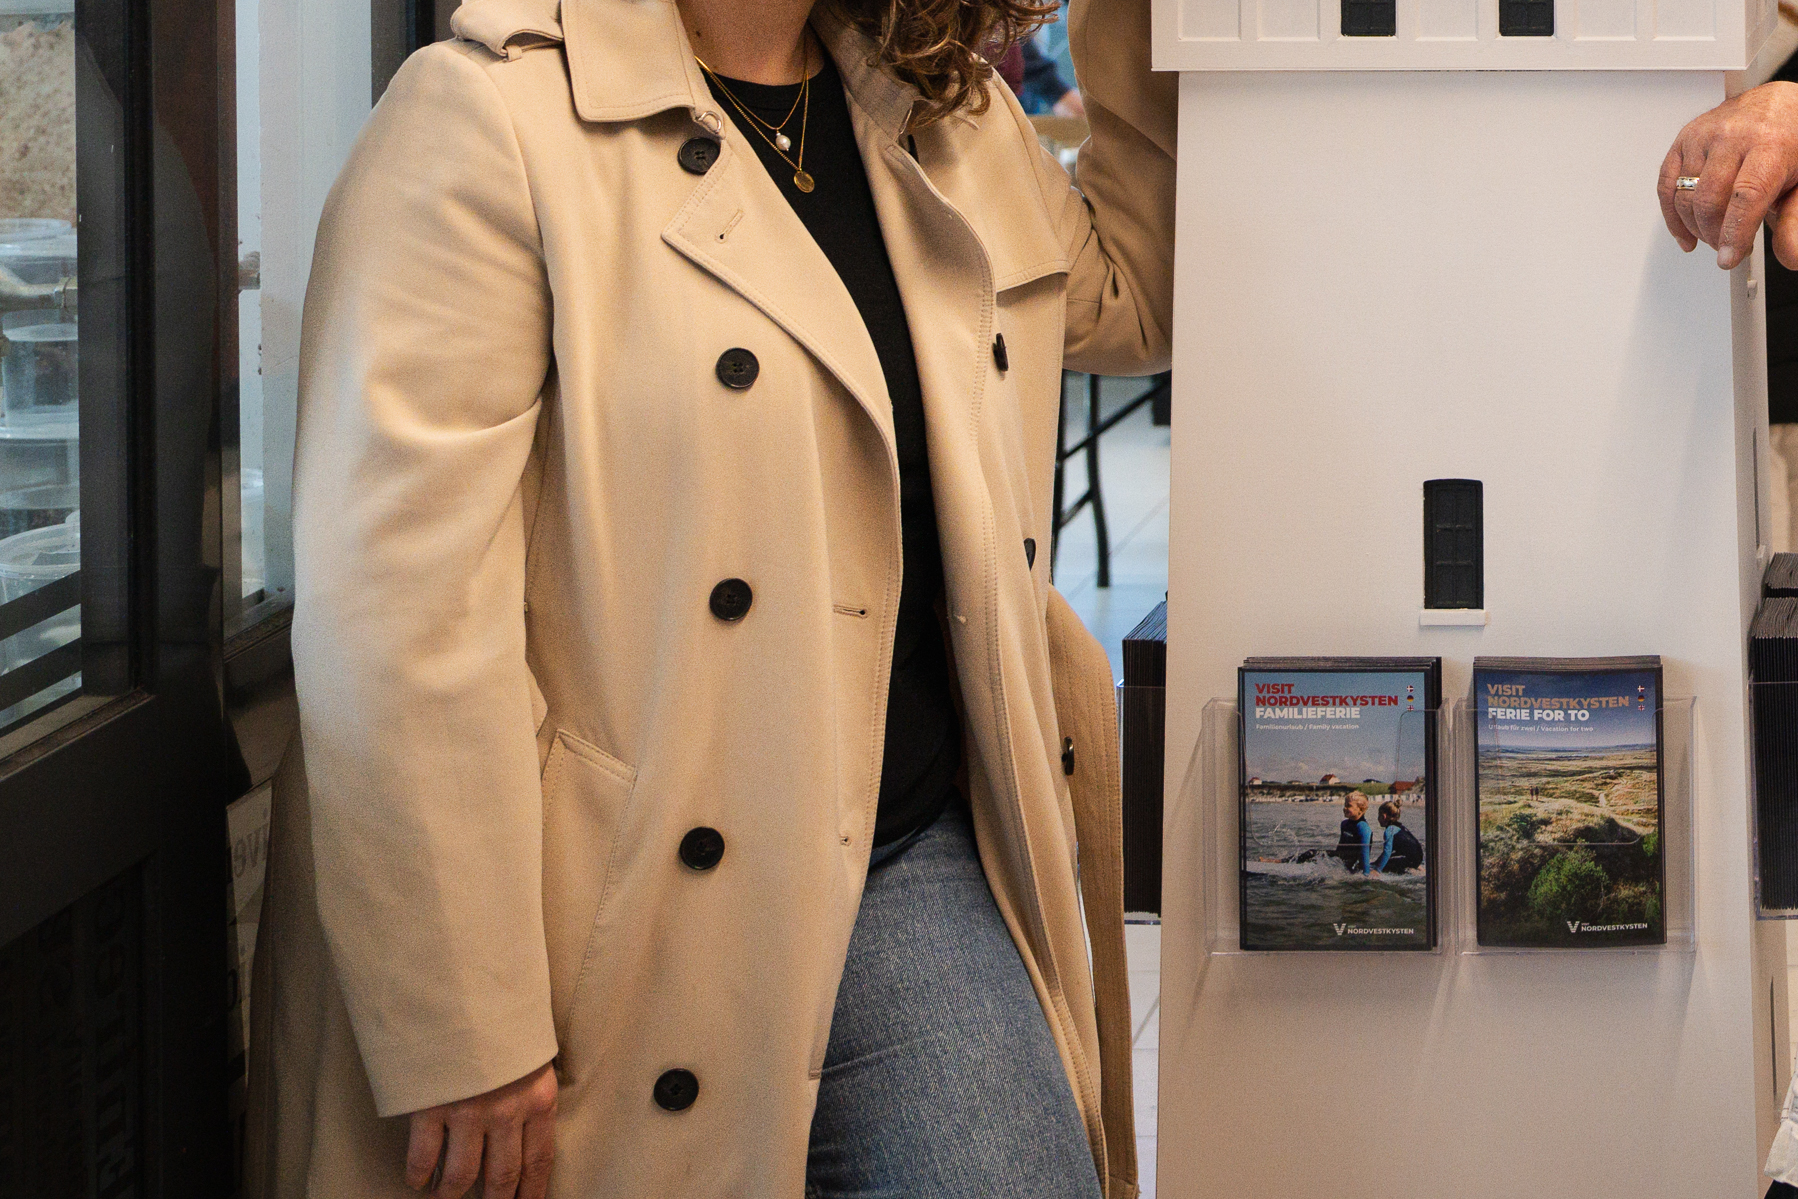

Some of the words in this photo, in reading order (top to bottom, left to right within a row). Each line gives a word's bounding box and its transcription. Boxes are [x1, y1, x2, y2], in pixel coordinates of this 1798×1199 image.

[1254, 683, 1295, 694] VISIT
[1487, 683, 1525, 696] VISIT
[1255, 695, 1398, 707] NORDVESTKYSTEN
[1487, 696, 1630, 709] NORDVESTKYSTEN
[1255, 707, 1360, 719] FAMILIEFERIE
[1488, 707, 1530, 720] FERIE
[1533, 709, 1565, 721] FOR
[1567, 710, 1590, 721] TO
[1308, 724, 1330, 732] Family
[1541, 725, 1568, 733] Vacation
[1581, 922, 1648, 932] NORDVESTKYSTEN
